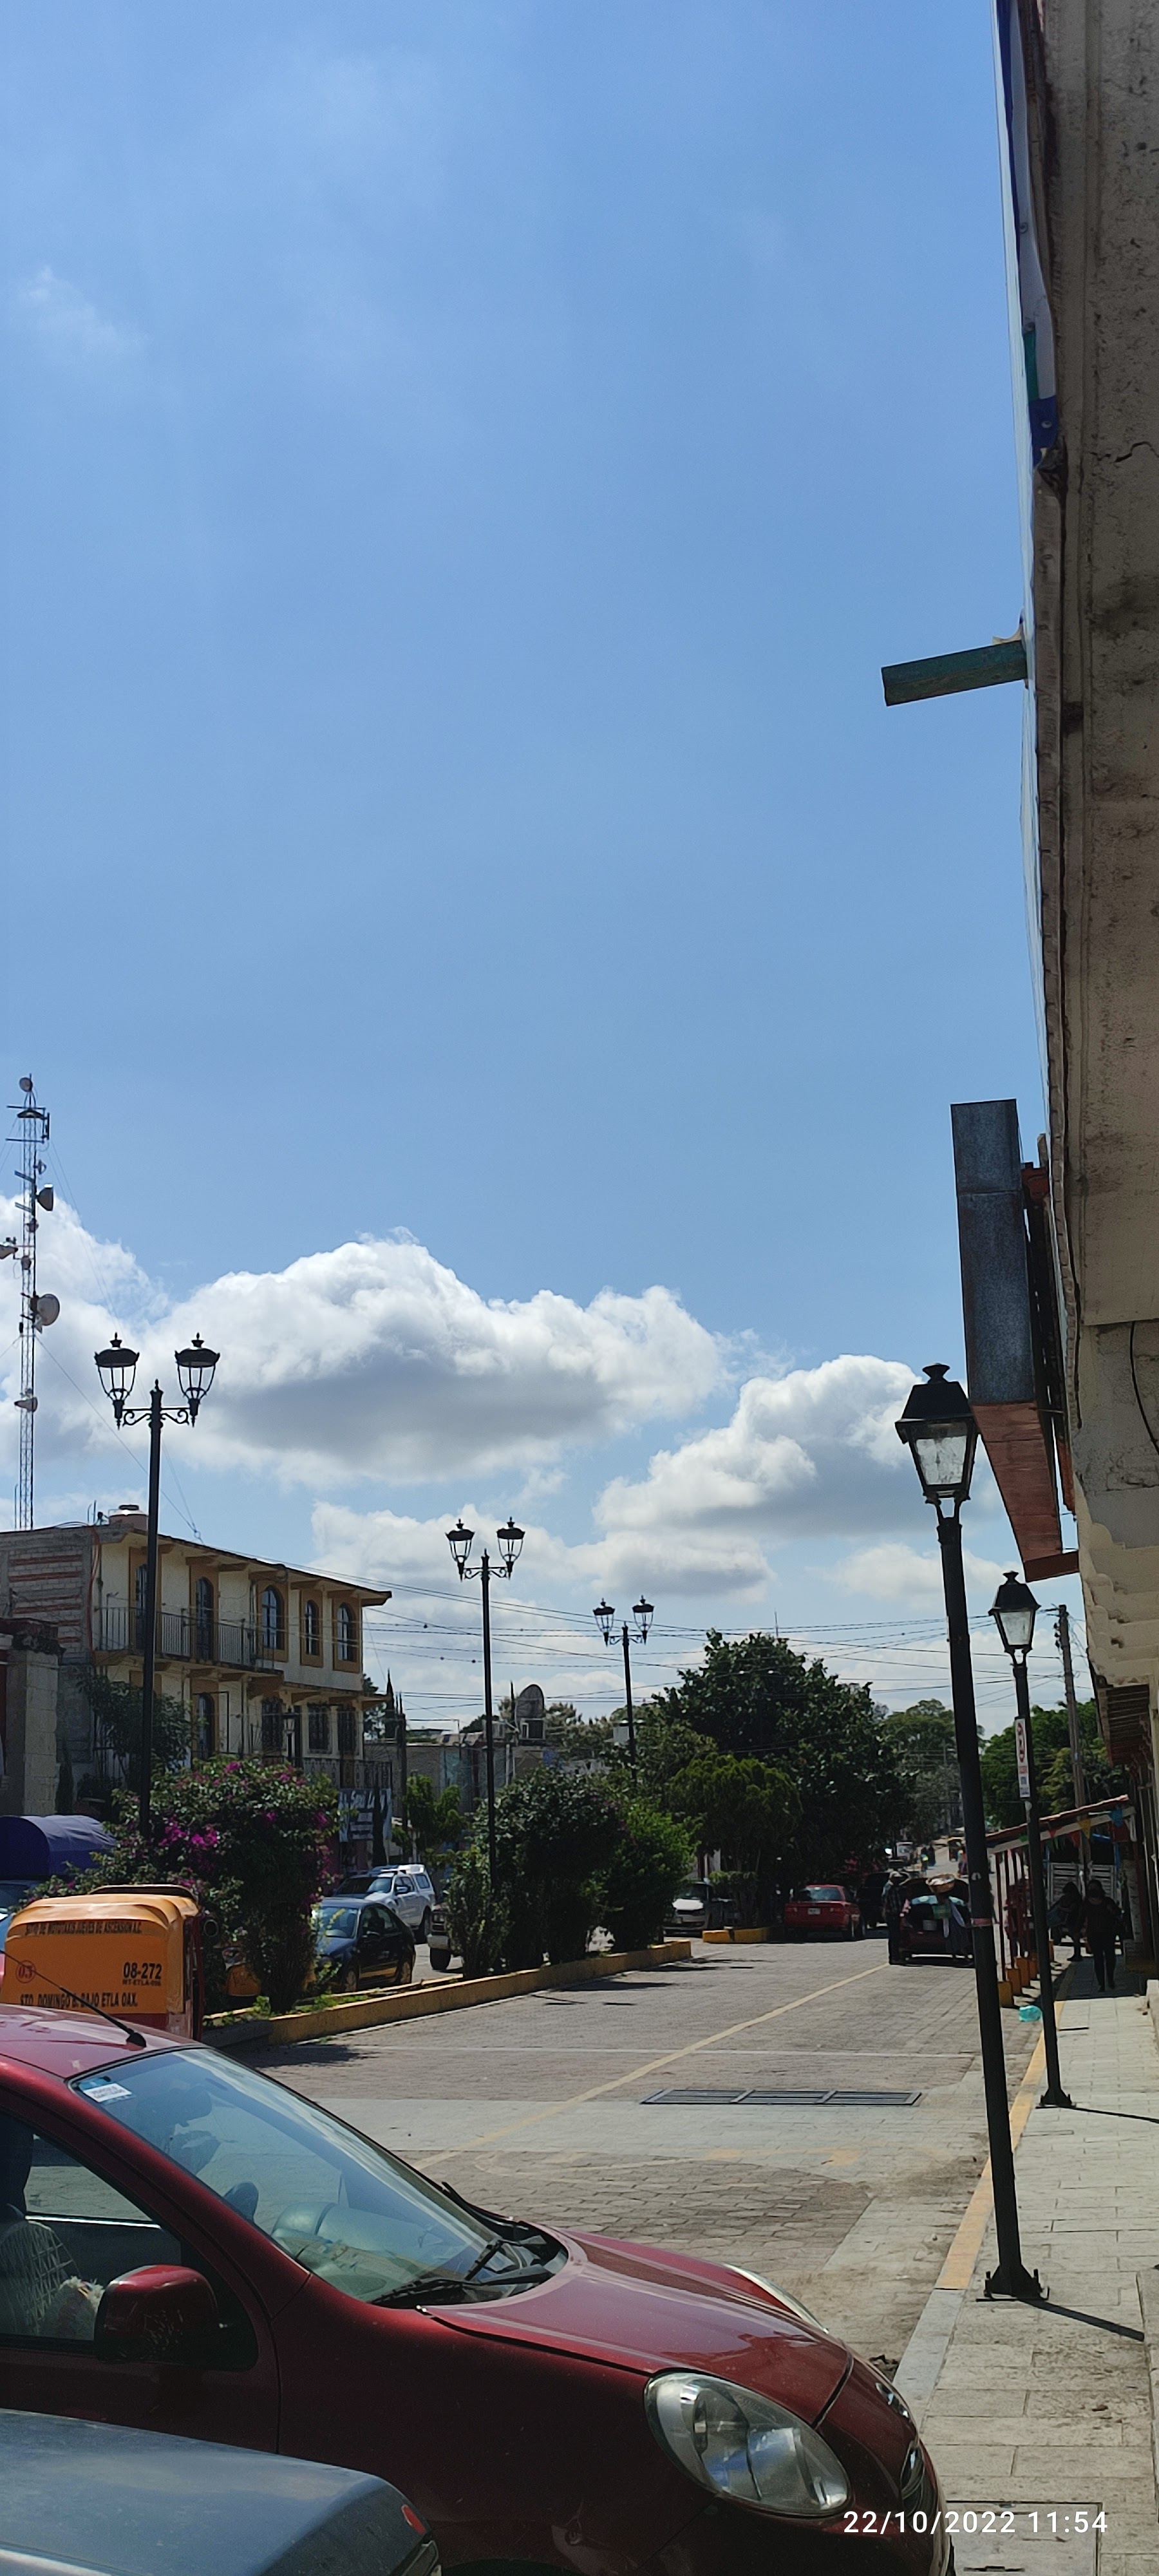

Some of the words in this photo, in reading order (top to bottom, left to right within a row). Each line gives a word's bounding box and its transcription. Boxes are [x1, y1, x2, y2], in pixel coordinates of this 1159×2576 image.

[123, 1962, 162, 1980] 08-272
[37, 1993, 70, 2009] DOMINGO
[101, 1993, 119, 2007] ETLA
